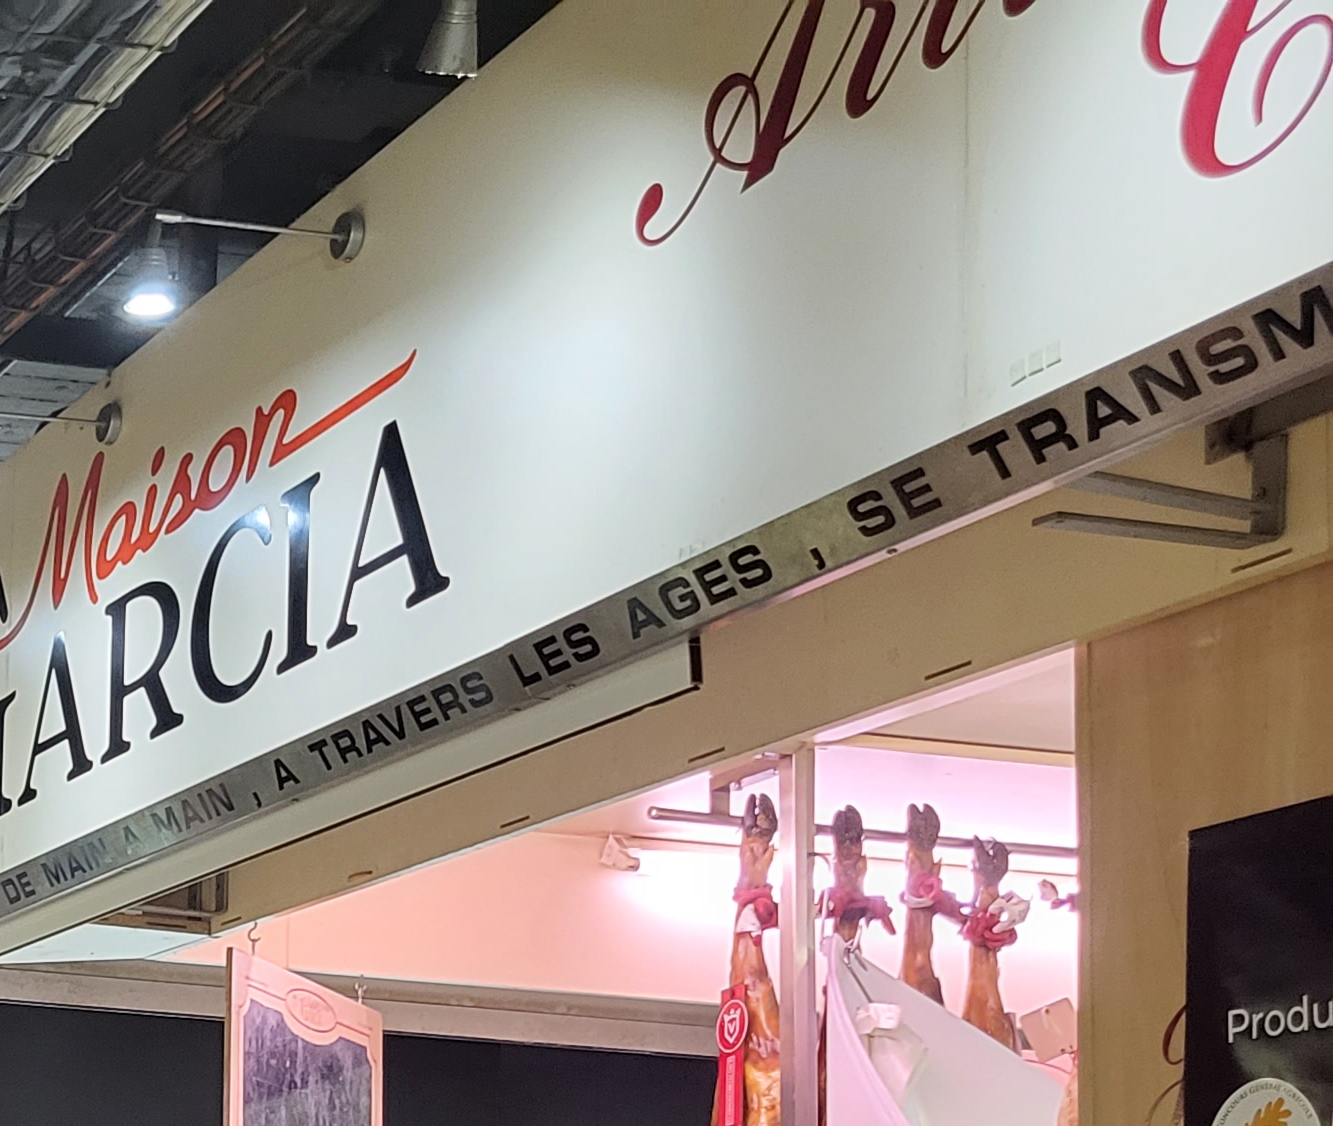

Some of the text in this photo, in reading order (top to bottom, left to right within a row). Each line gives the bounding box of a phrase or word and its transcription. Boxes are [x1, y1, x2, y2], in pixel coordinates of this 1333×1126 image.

[0, 869, 38, 906] DE
[41, 838, 115, 887] MAIN
[151, 782, 237, 836] MAIN
[275, 760, 305, 792] A
[309, 666, 497, 771] TRAVERS
[515, 622, 603, 690] LES
[627, 540, 775, 638] AGES
[845, 468, 943, 540] SE
